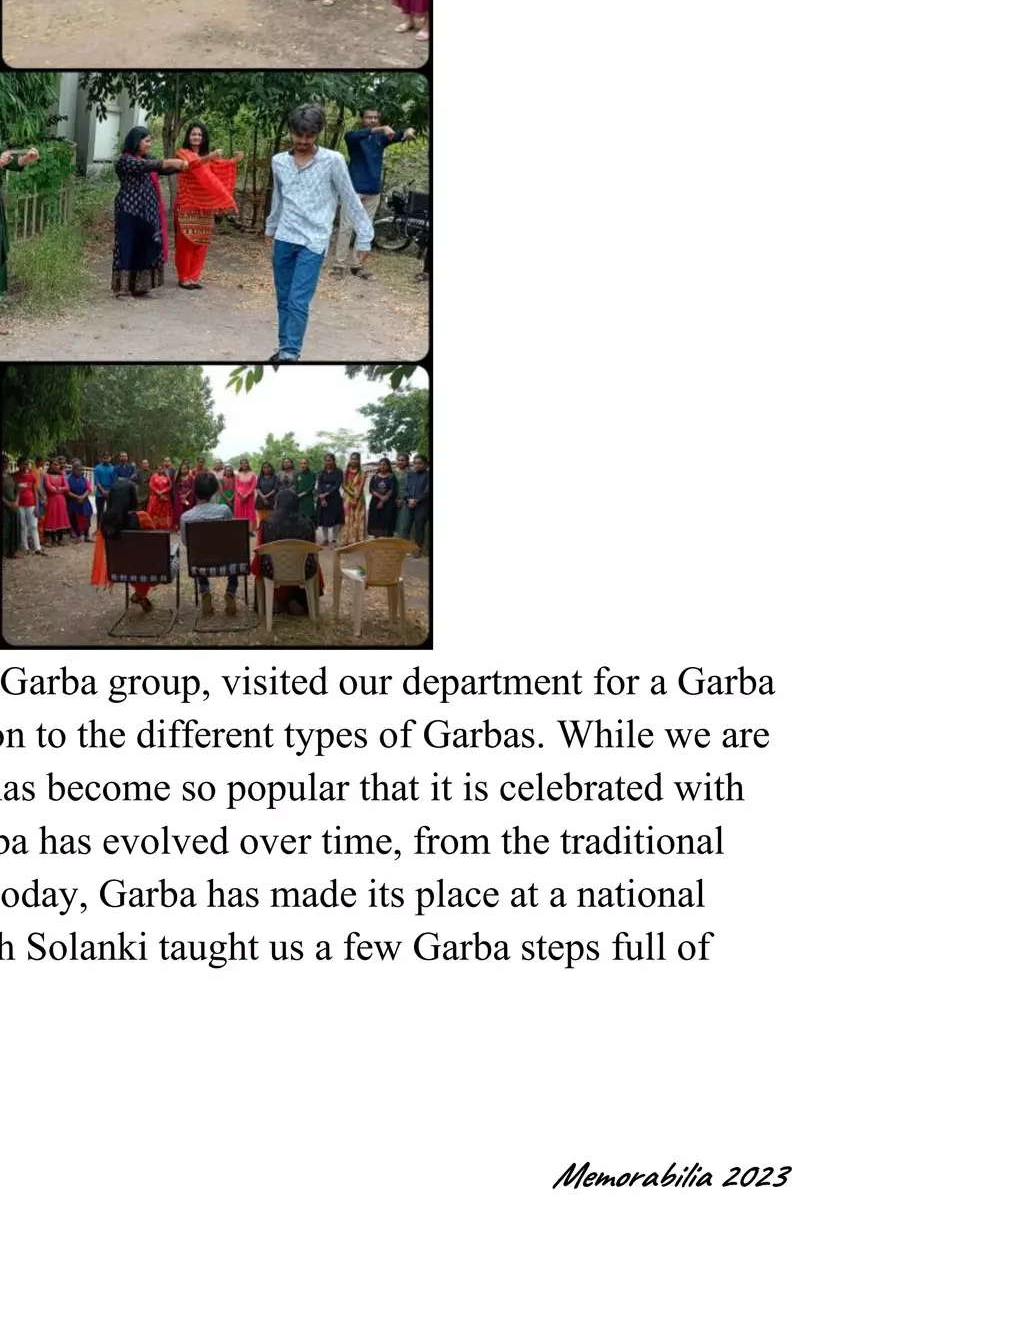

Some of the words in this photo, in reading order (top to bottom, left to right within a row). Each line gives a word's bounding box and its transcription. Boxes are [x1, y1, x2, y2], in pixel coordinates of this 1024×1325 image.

[1, 666, 98, 695] Garba
[109, 676, 209, 703] group,
[221, 666, 328, 695] visited
[340, 676, 392, 695] our
[403, 666, 582, 703] department
[594, 666, 640, 695] for
[651, 676, 667, 695] a
[679, 666, 775, 695] Garba
[36, 723, 66, 748] to
[77, 719, 125, 748] the
[137, 719, 274, 748] different
[284, 723, 367, 756] types
[380, 719, 416, 748] of
[424, 719, 543, 748] Garbas.
[557, 719, 653, 748] While
[665, 729, 710, 748] we
[723, 729, 769, 748] are
[46, 772, 170, 801] become
[183, 782, 215, 801] so
[227, 772, 350, 809] popular
[360, 772, 419, 801] that
[431, 772, 452, 801] it
[464, 772, 488, 801] is
[500, 772, 663, 801] celebrated
[674, 772, 744, 801] with
[39, 826, 91, 854] has
[103, 826, 229, 854] evolved
[240, 835, 312, 854] over
[322, 826, 401, 860] time,
[414, 826, 490, 854] from
[501, 826, 549, 854] the
[560, 826, 724, 854] traditional
[100, 879, 197, 907] Garba
[207, 879, 259, 907] has
[271, 879, 356, 907] made
[369, 879, 404, 907] its
[415, 879, 499, 915] place
[511, 883, 538, 907] at
[550, 888, 567, 907] a
[577, 879, 705, 907] national
[28, 932, 147, 960] Solanki
[159, 932, 259, 968] taught
[269, 941, 303, 960] us
[316, 941, 332, 960] a
[344, 932, 402, 960] few
[414, 932, 510, 960] Garba
[522, 936, 599, 968] steps
[612, 932, 666, 960] full
[678, 932, 714, 960] of
[553, 1162, 712, 1189] Memorabilia
[722, 1166, 792, 1187] 2023
